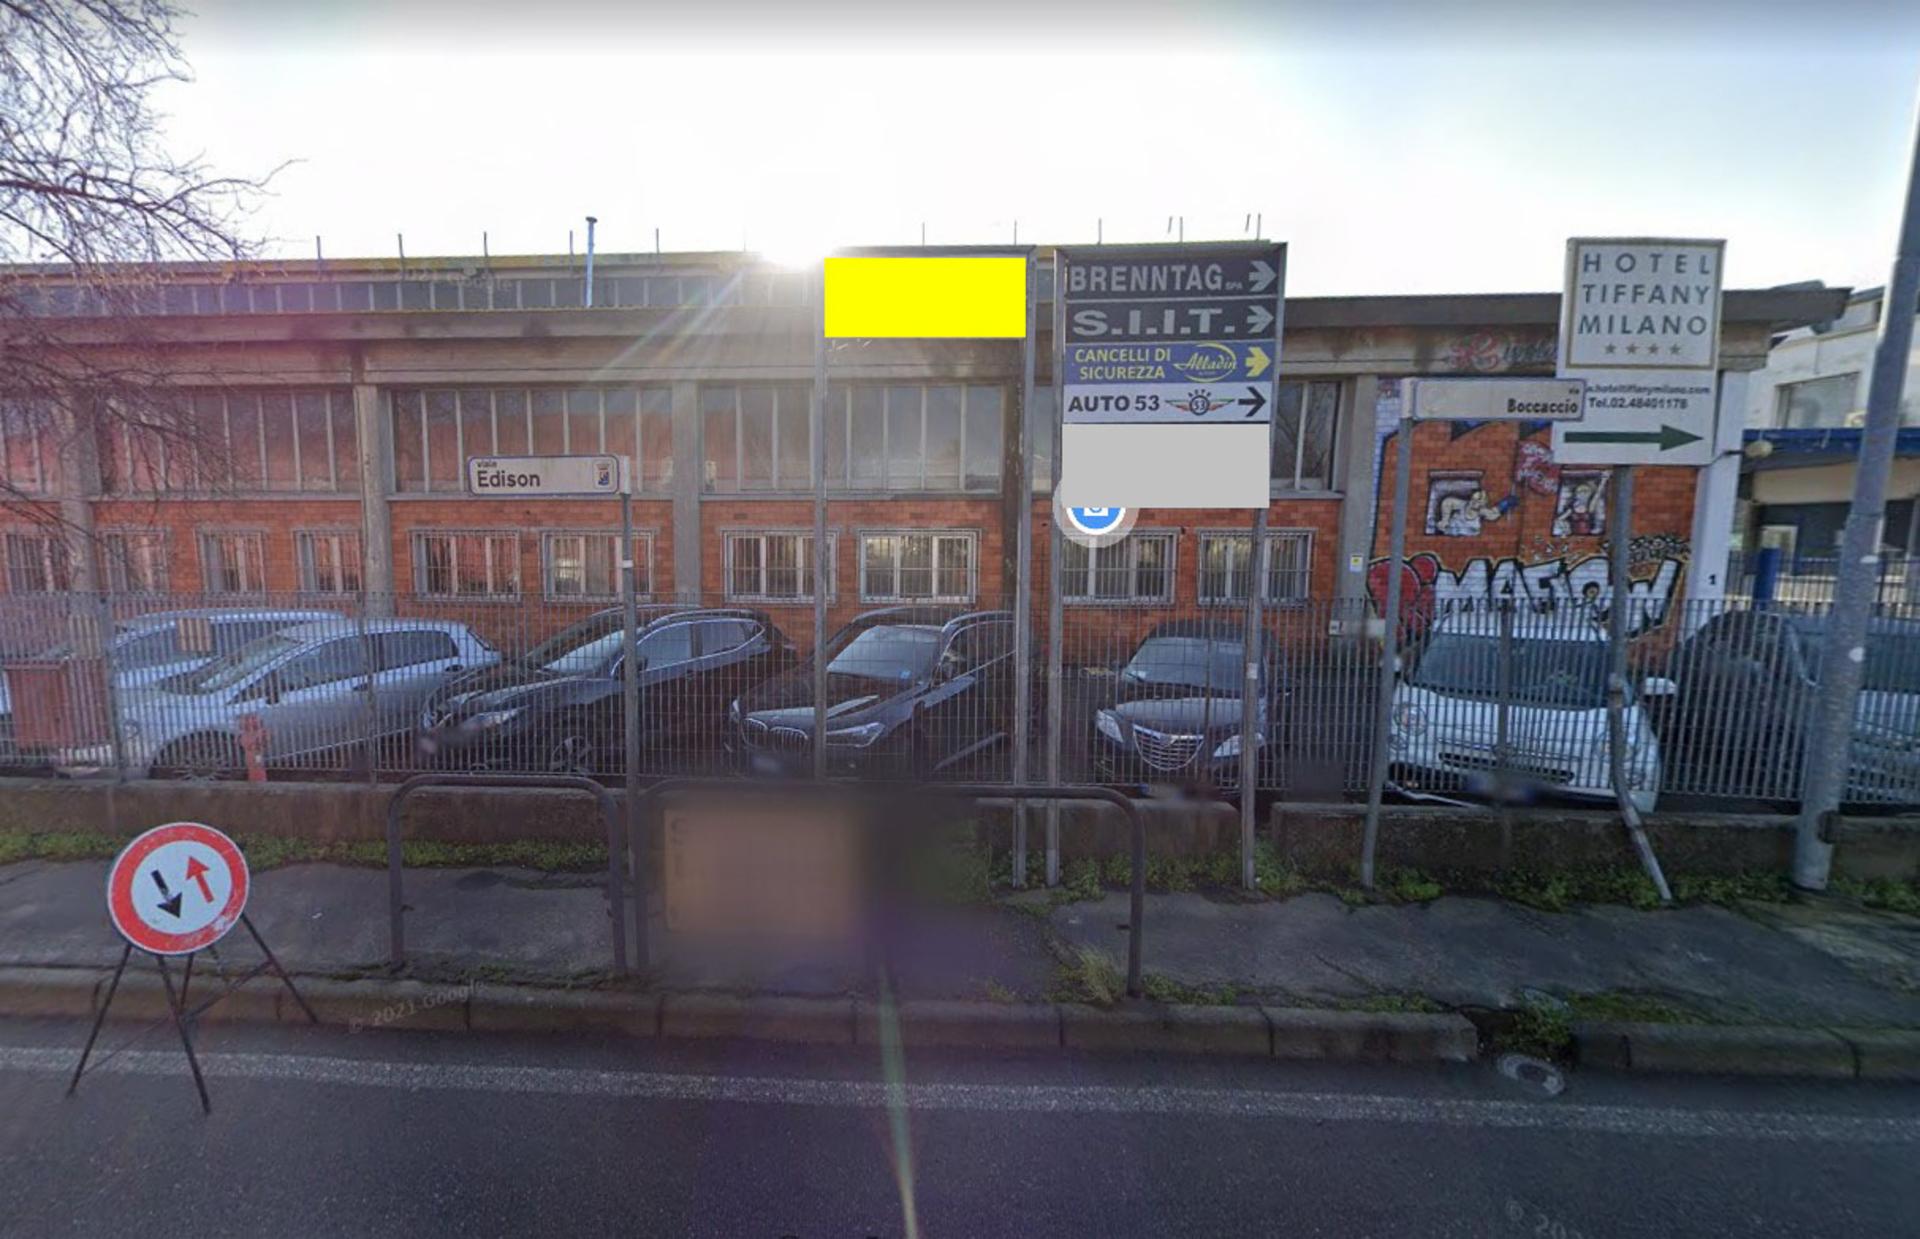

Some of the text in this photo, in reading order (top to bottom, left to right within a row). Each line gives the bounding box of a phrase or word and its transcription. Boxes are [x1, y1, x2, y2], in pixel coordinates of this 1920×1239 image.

[1583, 253, 1711, 274] HOTEL
[1069, 263, 1222, 292] BRENNTAG
[1582, 284, 1711, 305] TIFFANY
[1073, 308, 1235, 336] S.I.I.T.
[1578, 315, 1708, 335] MILANO
[1075, 348, 1171, 363] CANCELLI DI
[1080, 366, 1165, 380] SICUREZZA
[1068, 395, 1160, 413] AUTO 53
[1507, 398, 1578, 414] Boccaccio
[477, 469, 541, 487] Edison
